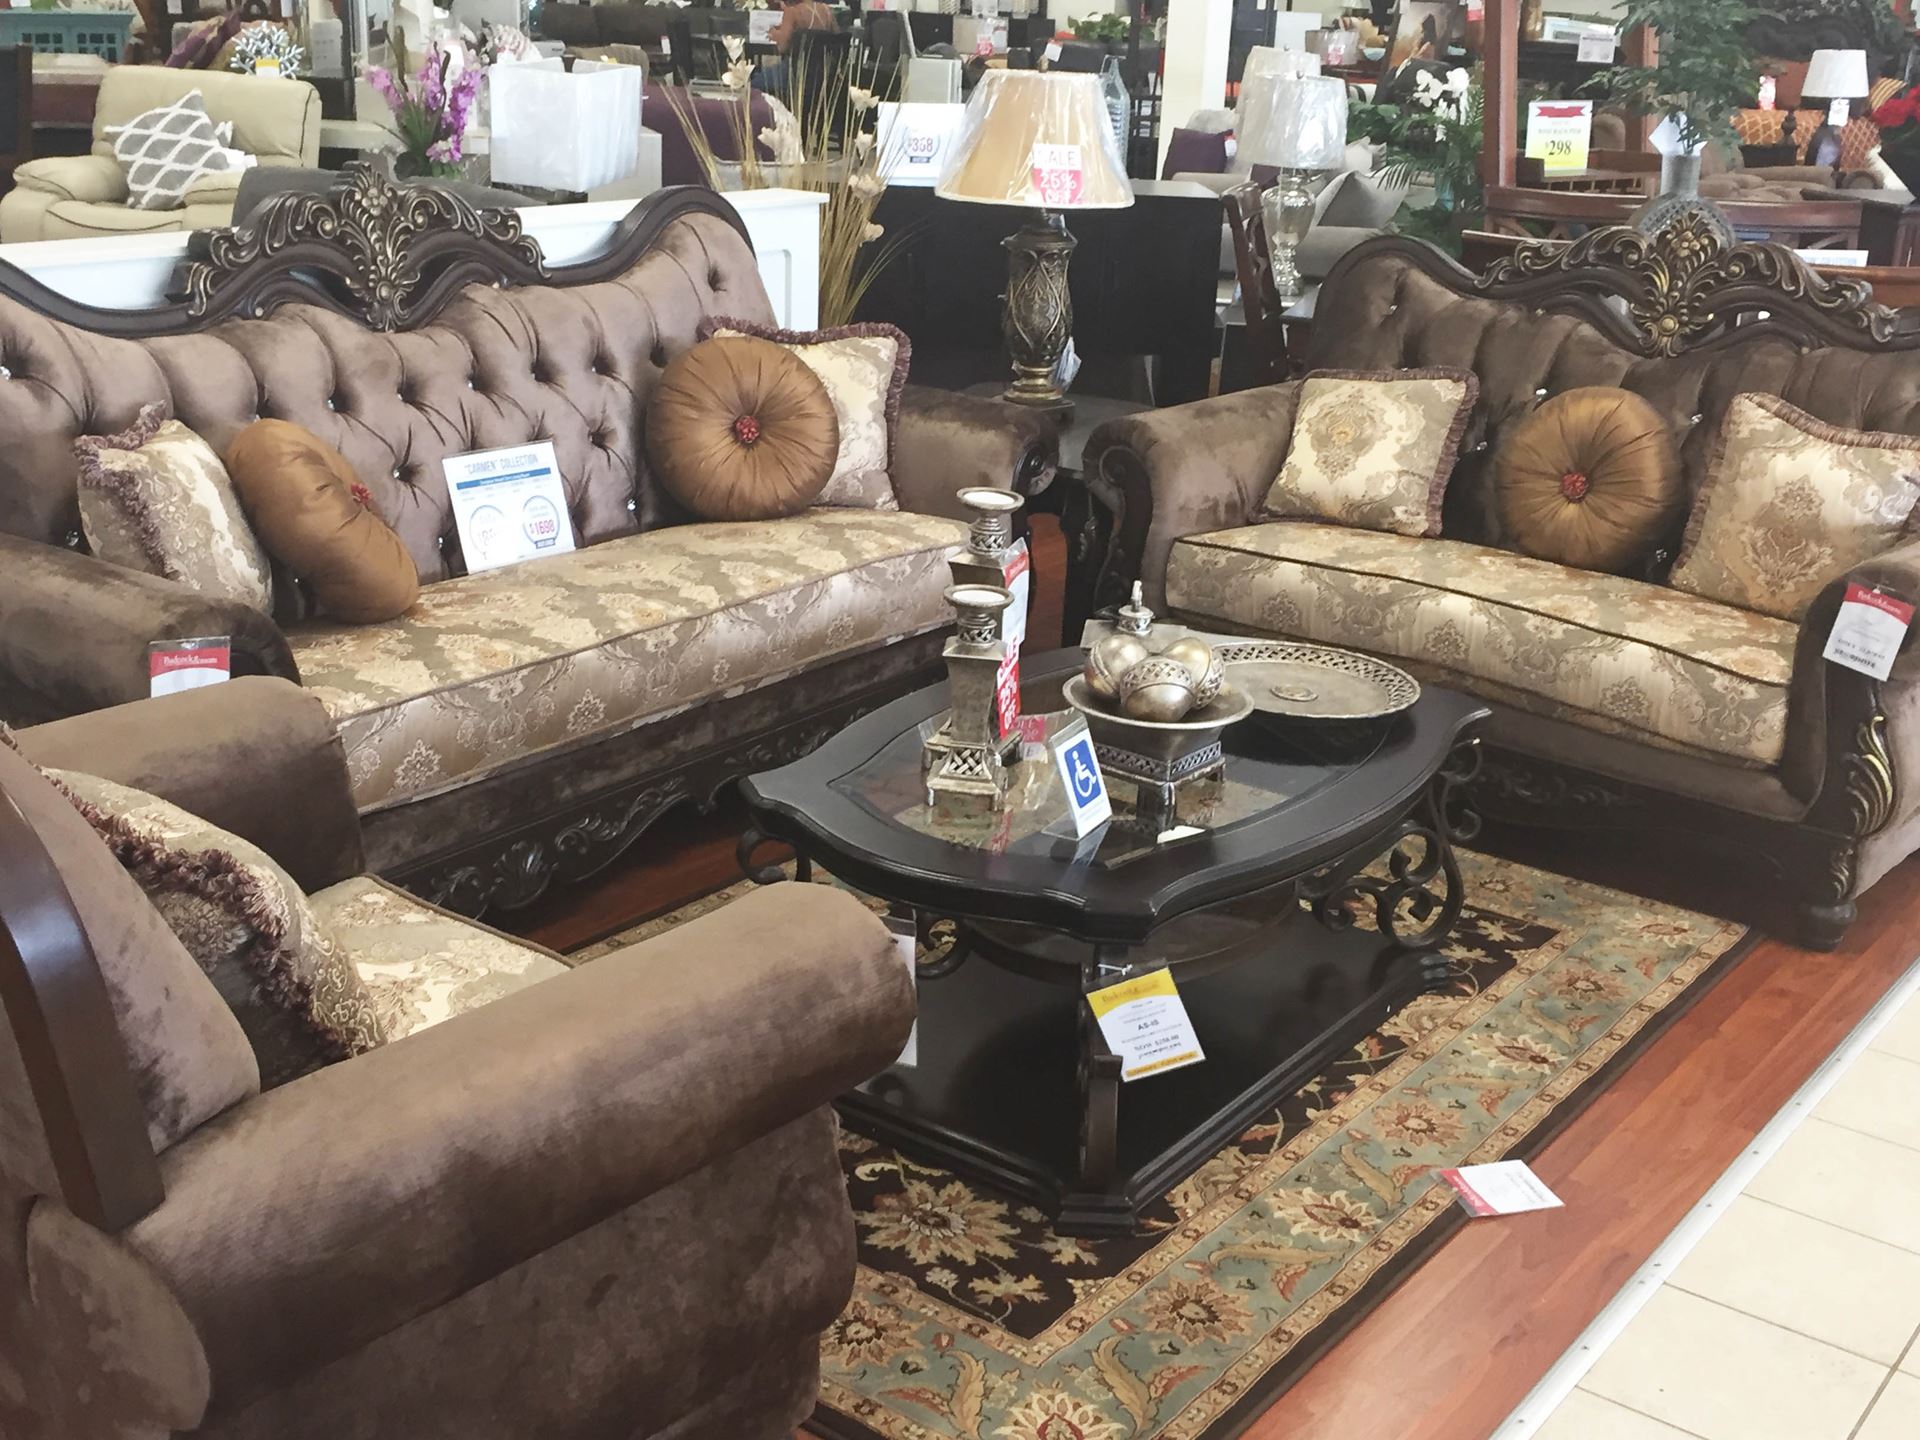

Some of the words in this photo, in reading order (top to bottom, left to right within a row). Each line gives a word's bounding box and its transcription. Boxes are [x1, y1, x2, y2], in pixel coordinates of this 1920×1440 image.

[1545, 139, 1572, 156] $298
[499, 453, 539, 471] COLLECTION
[1138, 1019, 1160, 1031] AS-IS
